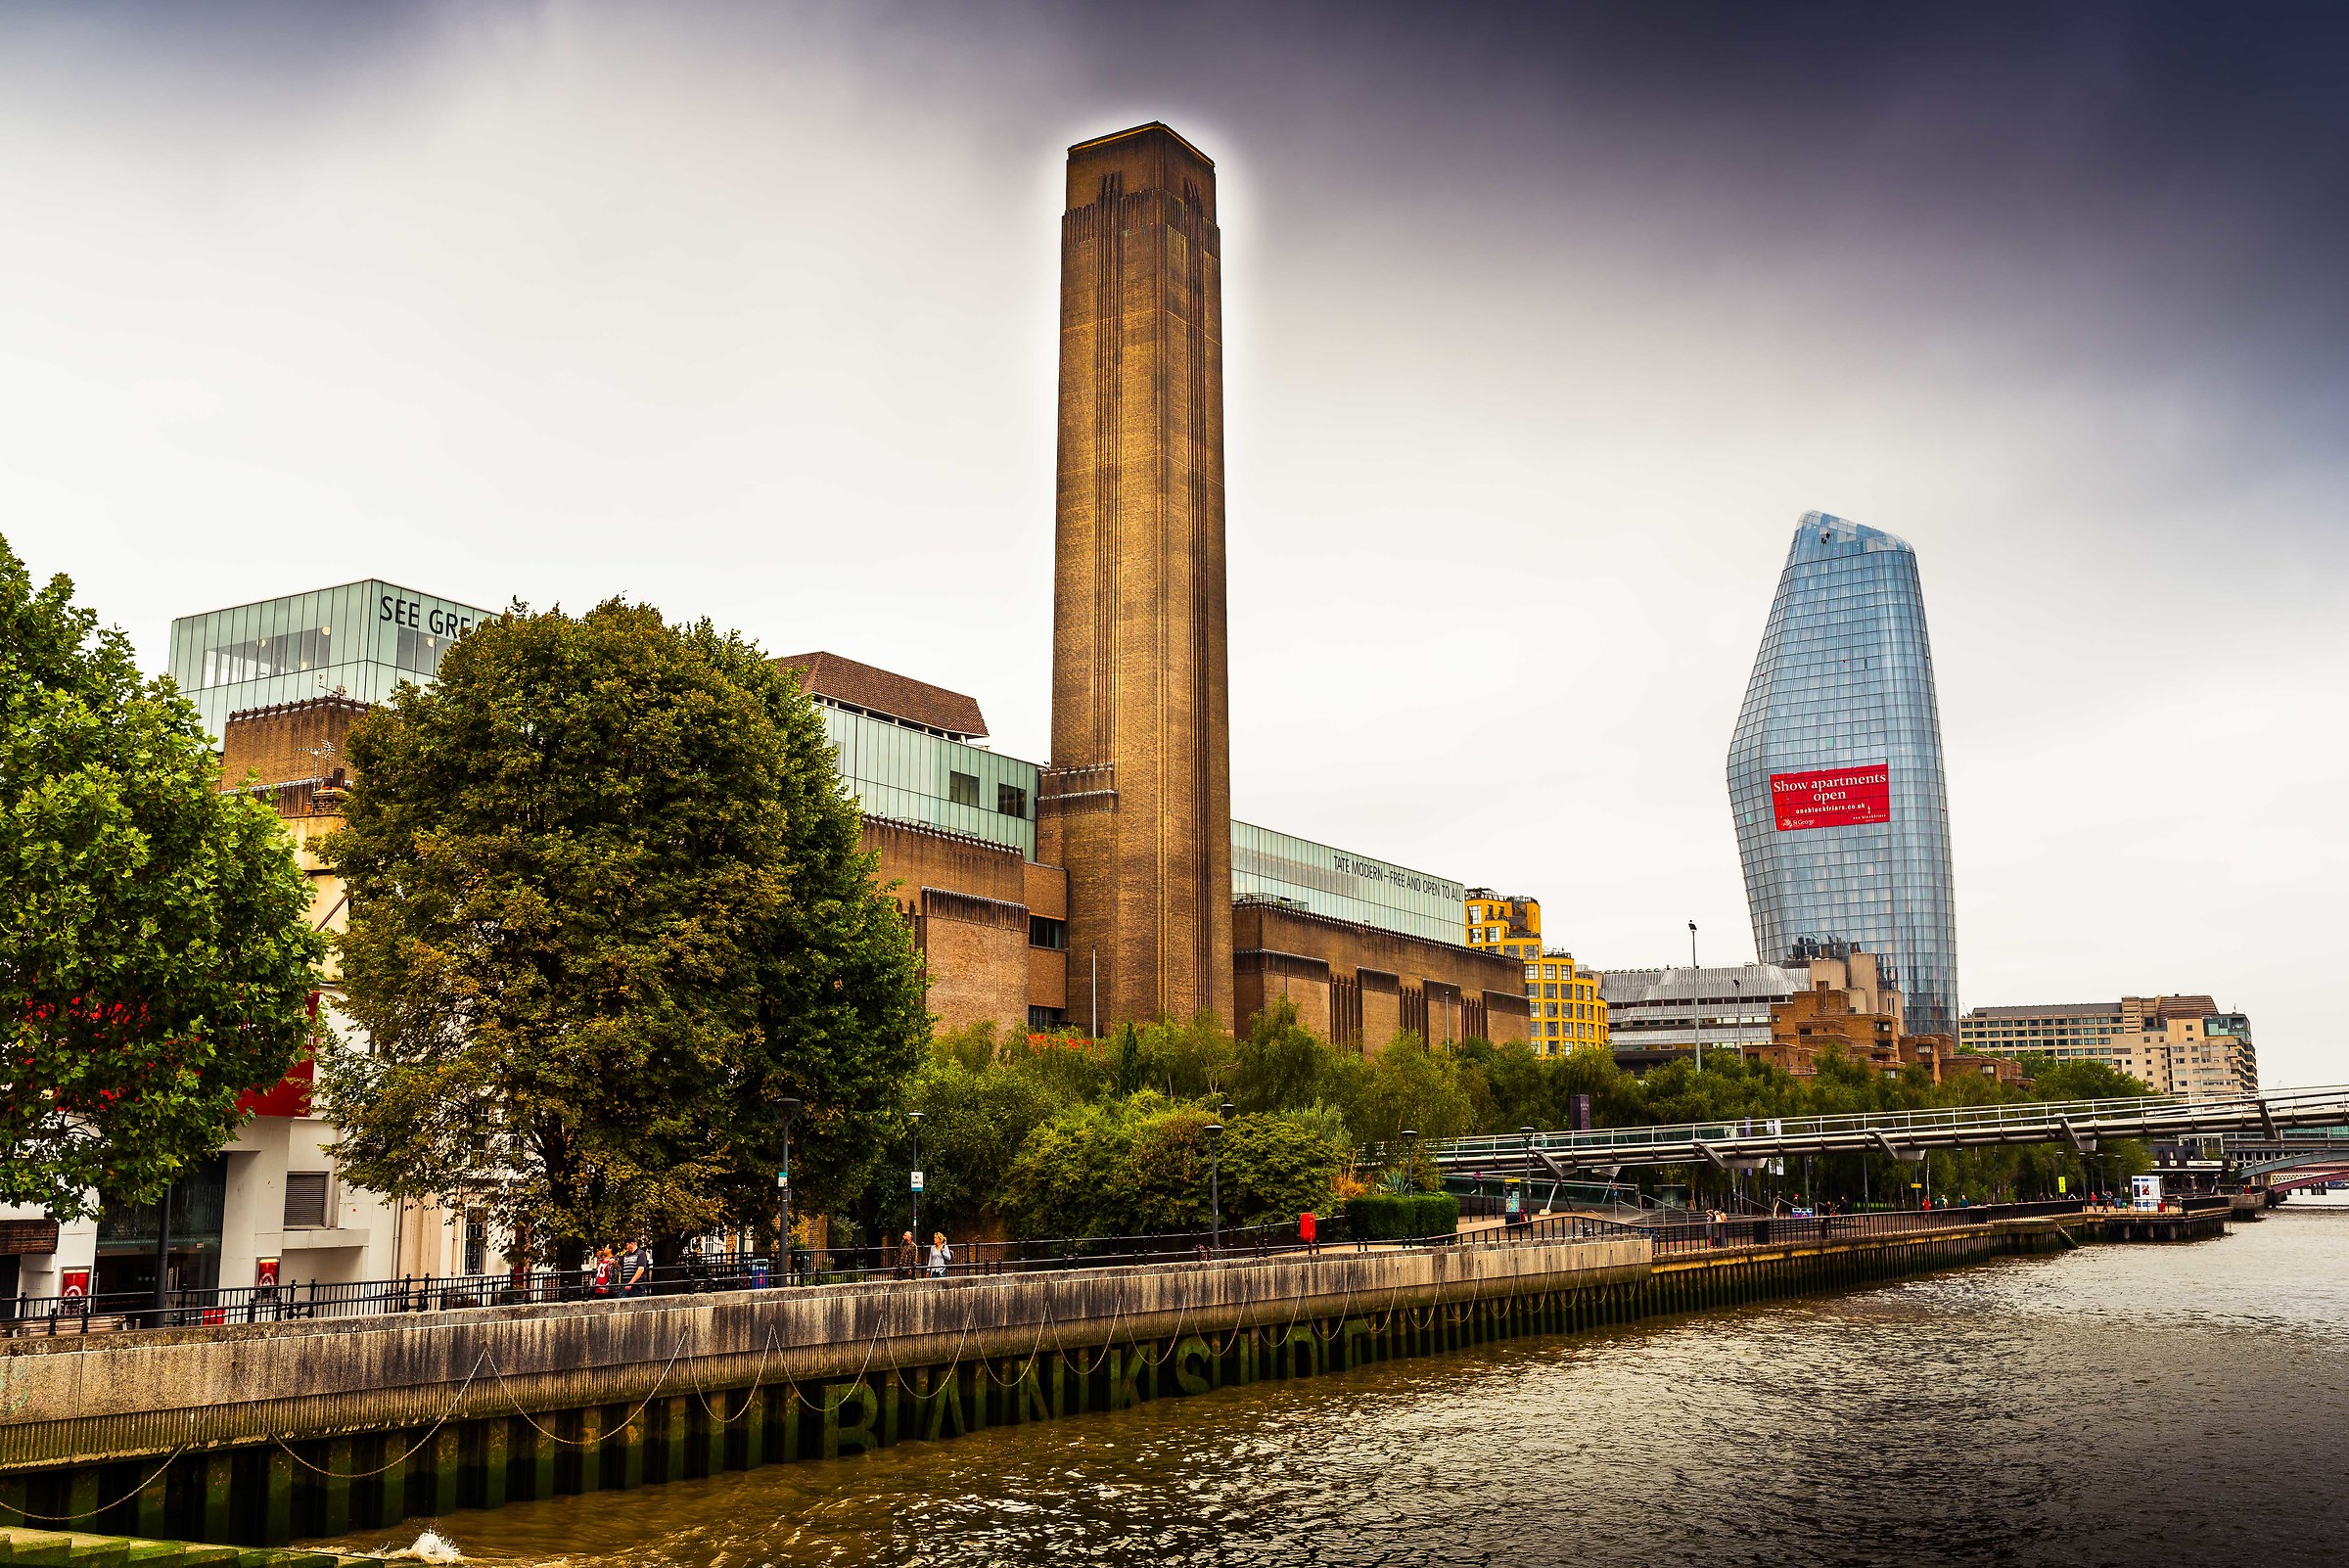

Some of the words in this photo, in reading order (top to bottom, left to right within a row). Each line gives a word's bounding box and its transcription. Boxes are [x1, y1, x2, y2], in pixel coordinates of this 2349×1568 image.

[380, 595, 420, 628] SEE
[1773, 780, 1808, 793] Show
[1811, 773, 1886, 792] apartments
[1813, 791, 1847, 805] open
[1795, 803, 1865, 814] oneblackfriars.co.uk
[1334, 855, 1350, 873] TATE
[1352, 860, 1383, 882] MODERN
[1390, 870, 1405, 888] FREE
[1406, 875, 1421, 892] AND
[1423, 880, 1441, 897] OPEN
[1442, 885, 1450, 899] TO
[1451, 886, 1462, 902] ALL
